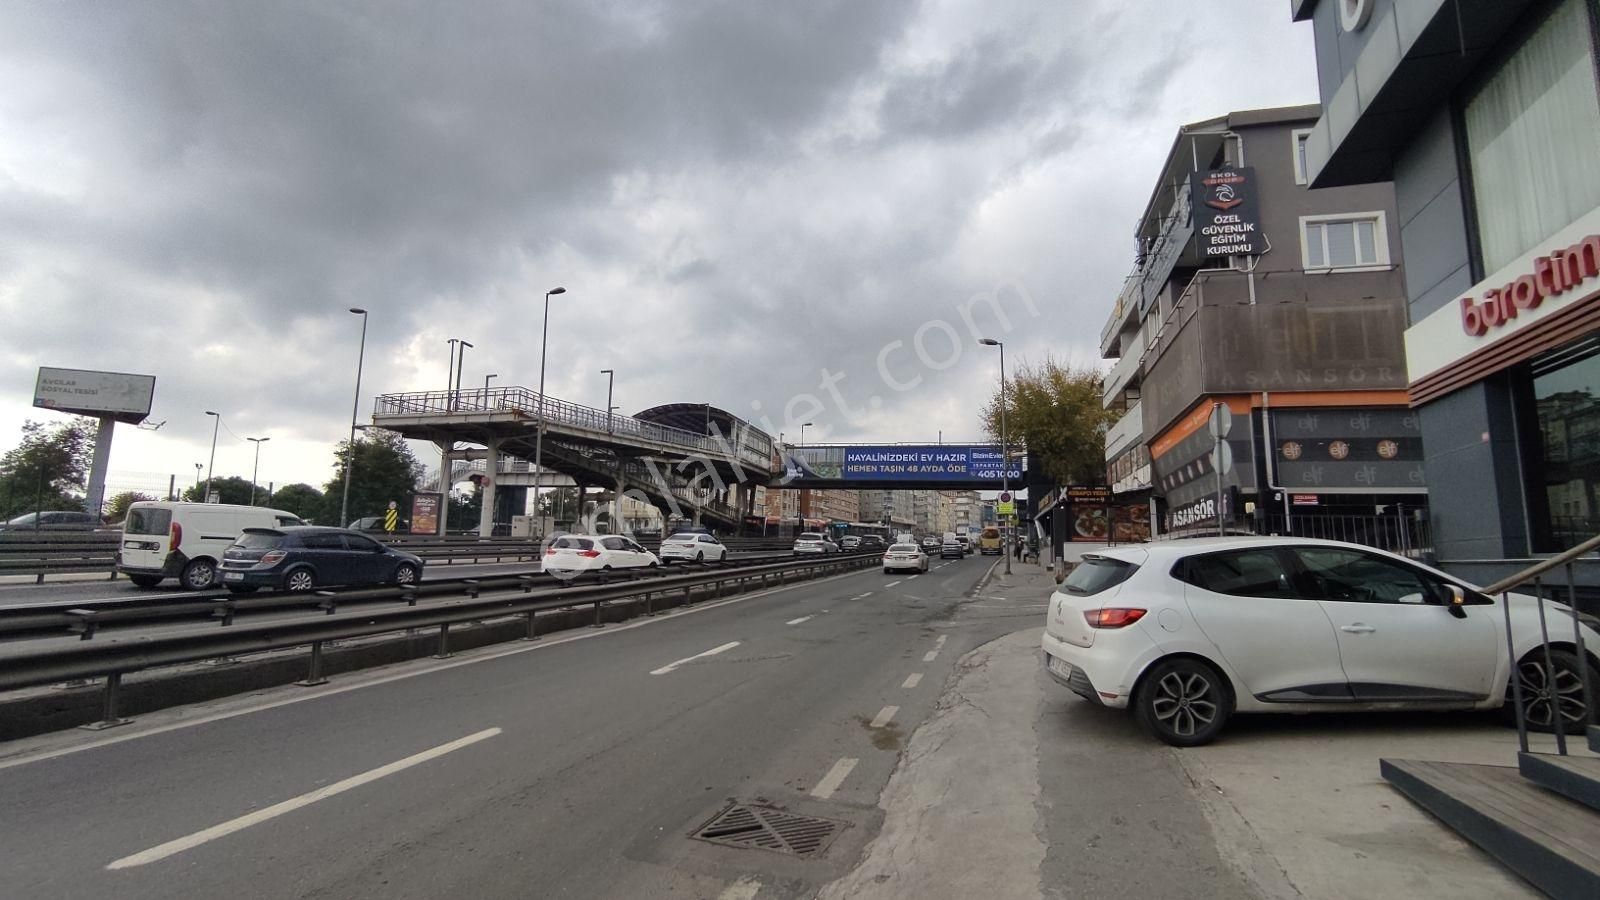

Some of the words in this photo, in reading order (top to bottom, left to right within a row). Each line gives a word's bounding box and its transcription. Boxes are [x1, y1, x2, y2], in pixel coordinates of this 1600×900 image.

[1214, 214, 1241, 224] ÖZEL
[1202, 223, 1254, 235] GÜVENLİK
[1211, 234, 1246, 245] EĞİTİM
[1207, 244, 1252, 255] KURUMU
[848, 452, 918, 462] HAYALİNİZDEKİ
[921, 453, 934, 462] EV
[936, 453, 967, 462] HAZIR
[880, 465, 905, 473] TAŞIN
[947, 463, 967, 472] ÖDE
[1173, 498, 1216, 528] ASANSÖR
